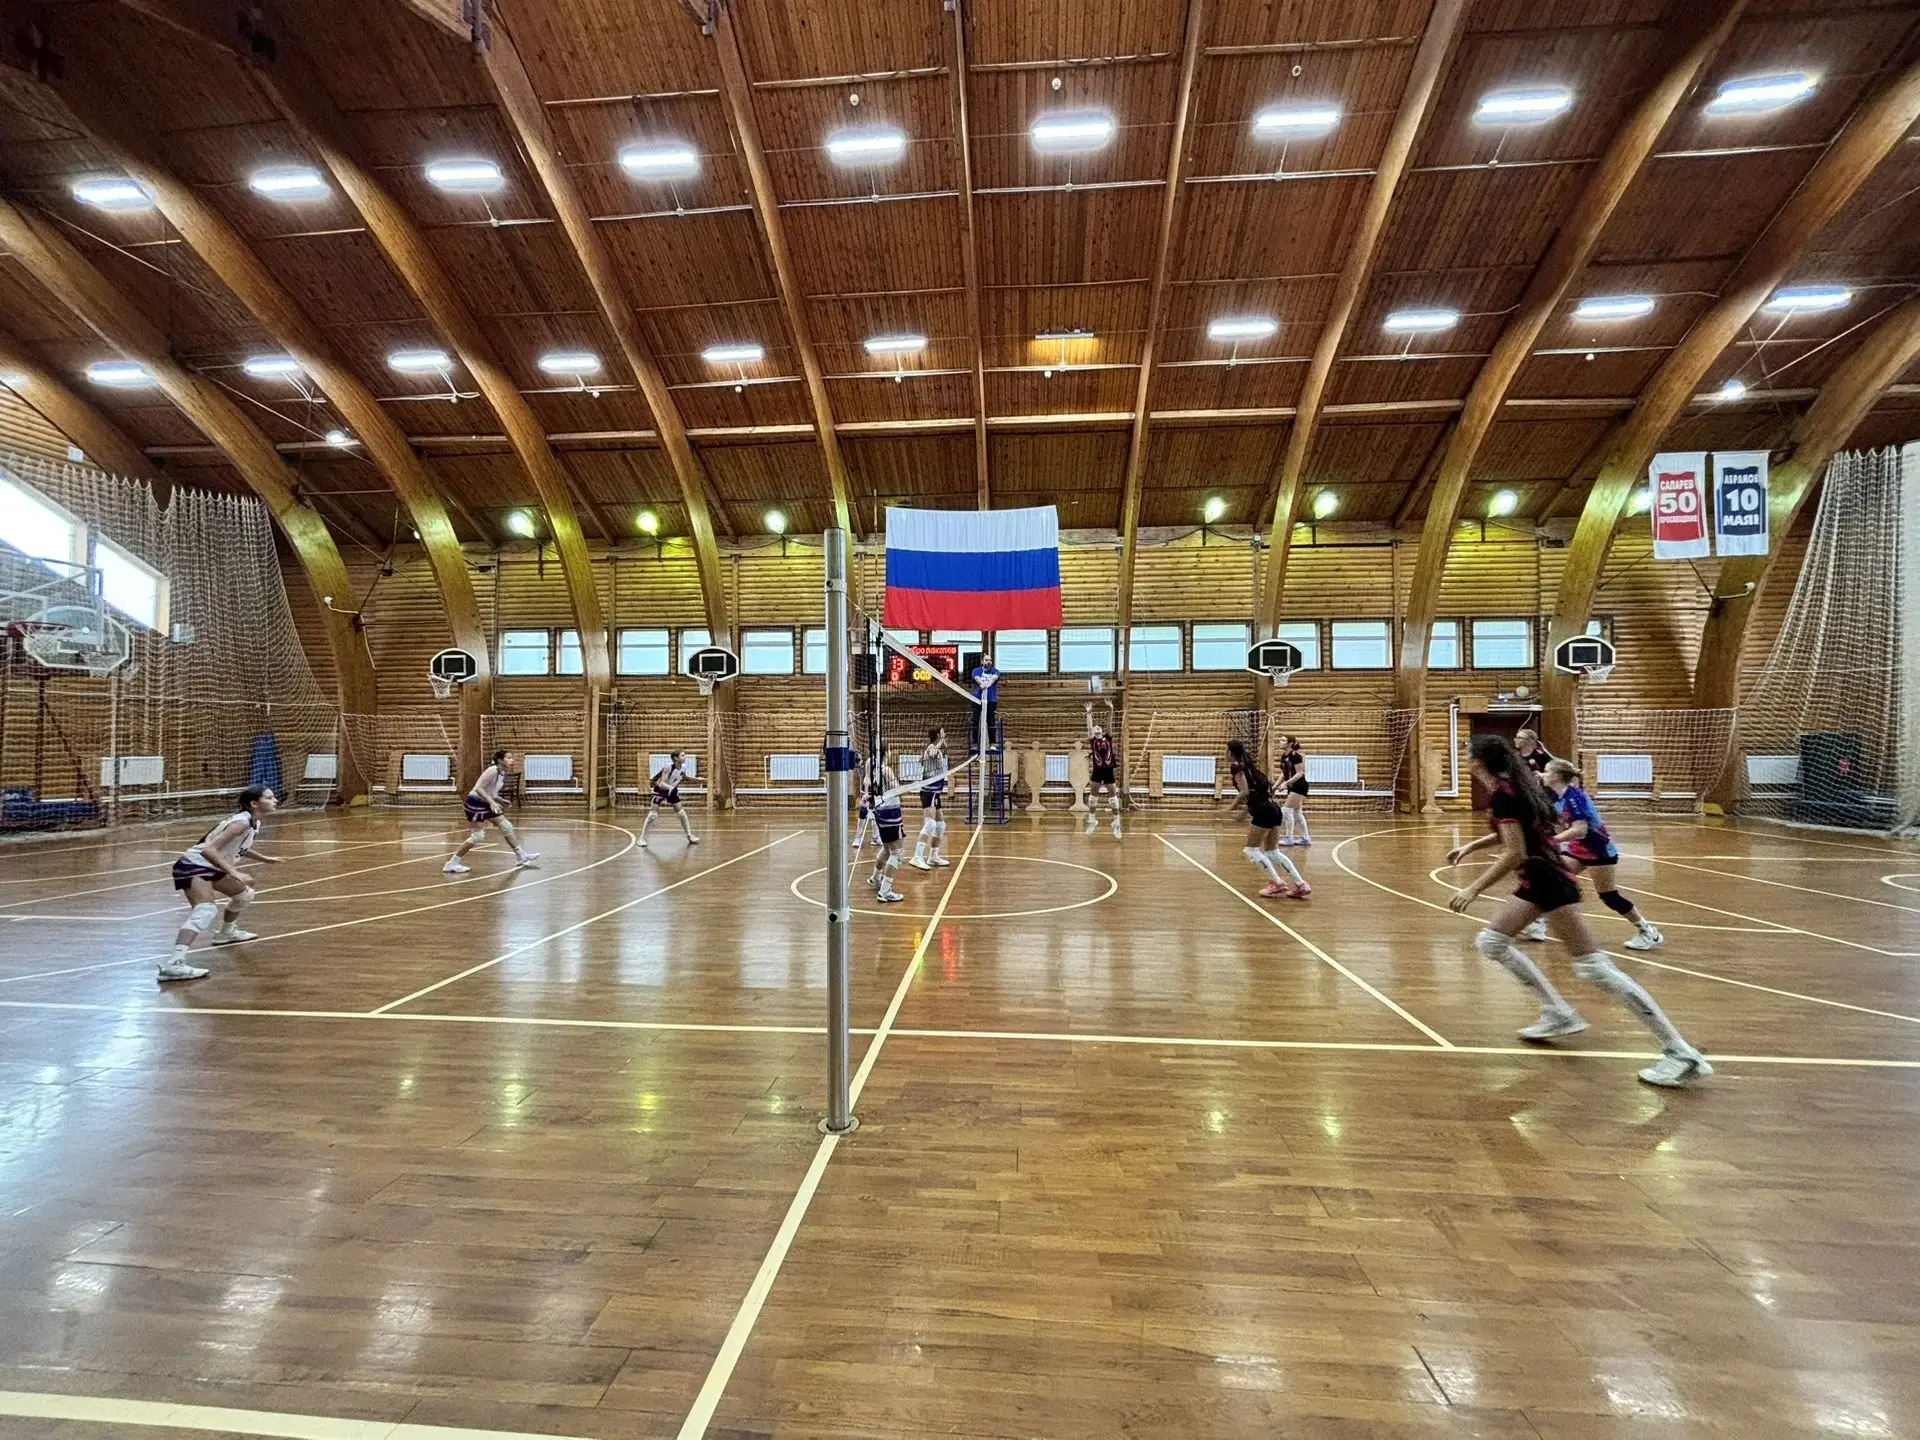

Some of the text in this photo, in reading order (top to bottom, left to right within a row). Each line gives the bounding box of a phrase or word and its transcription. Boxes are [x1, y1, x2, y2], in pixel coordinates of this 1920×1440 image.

[1659, 491, 1697, 513] 50
[1726, 488, 1759, 512] 10
[892, 658, 904, 671] 13
[946, 658, 954, 670] 7
